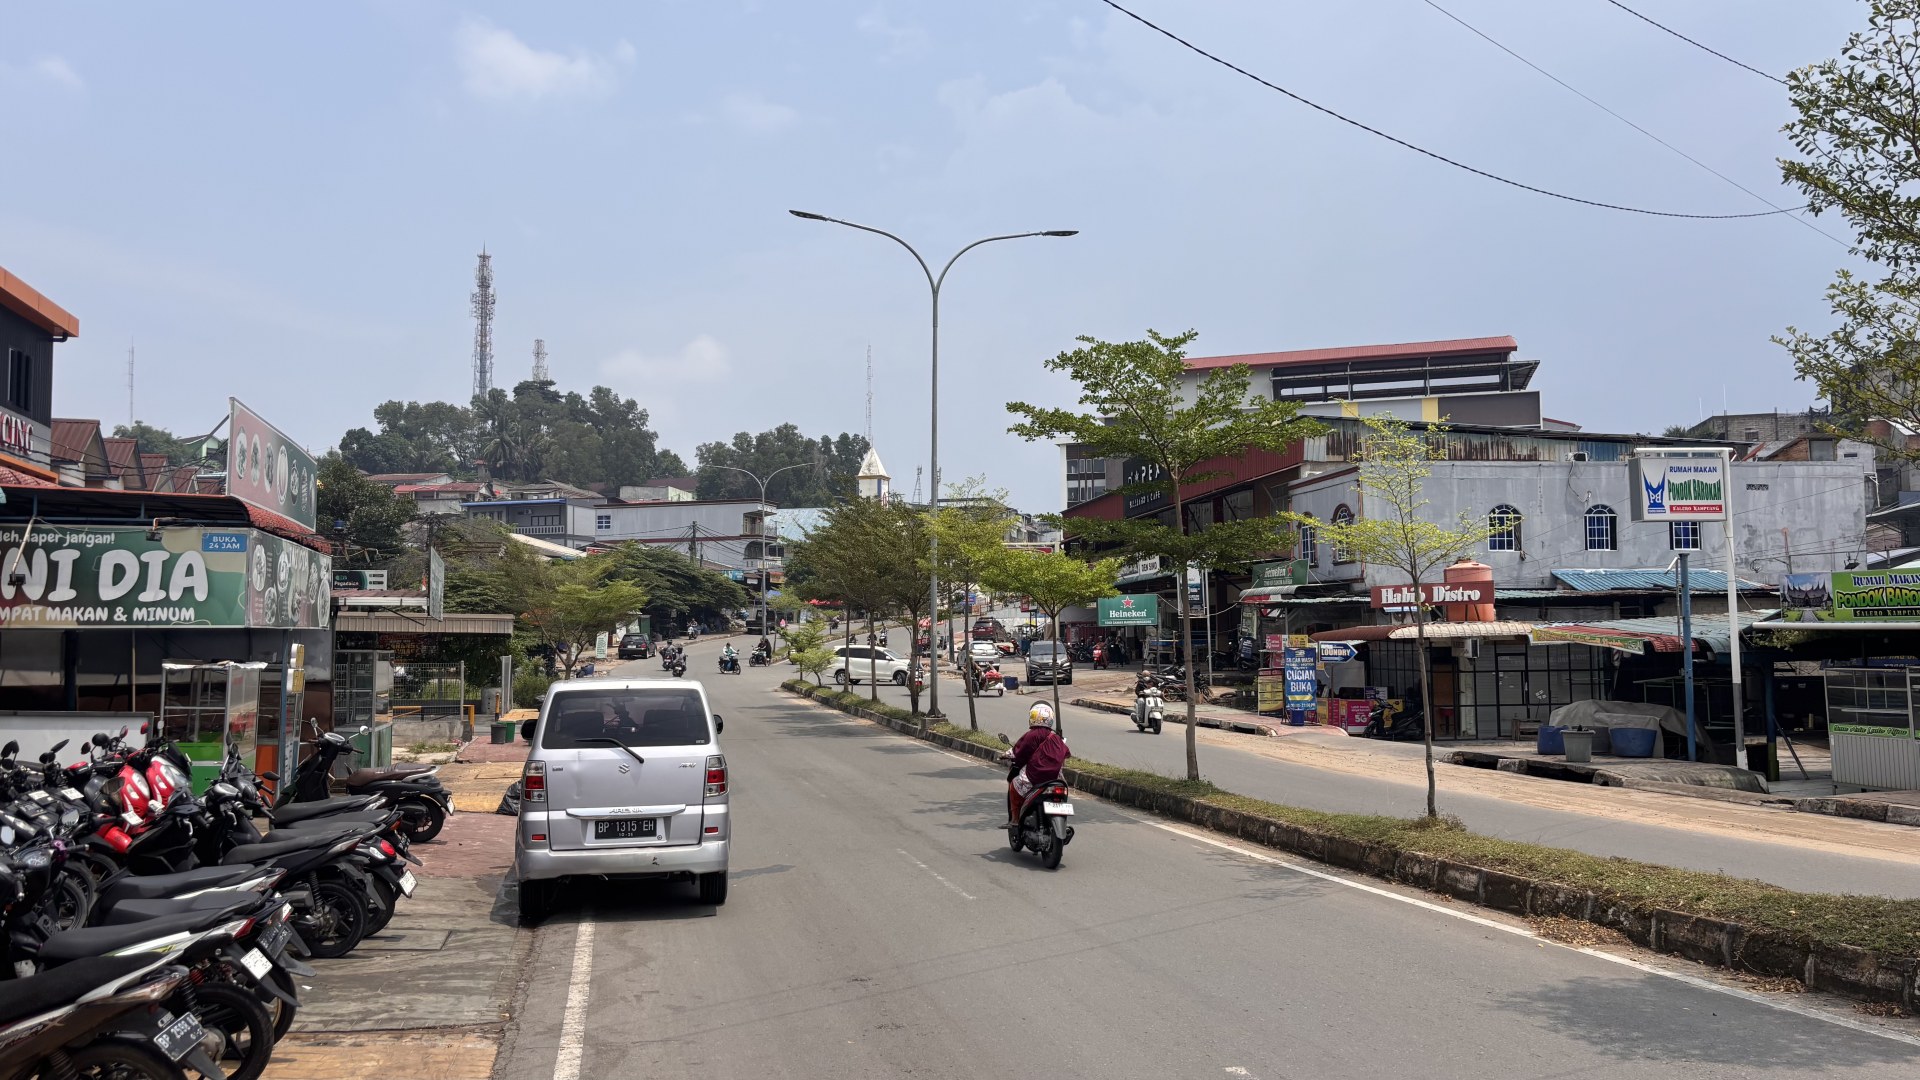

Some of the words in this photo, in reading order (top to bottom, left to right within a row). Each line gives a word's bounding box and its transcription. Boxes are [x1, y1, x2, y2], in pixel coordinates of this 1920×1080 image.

[1667, 478, 1693, 501] PONDOK
[1693, 478, 1722, 501] BAROKAH
[63, 531, 115, 548] jangan!
[98, 549, 209, 602] DIA
[1852, 575, 1885, 586] RUMAH
[1432, 585, 1480, 602] Distro
[1837, 587, 1885, 608] PONDOK
[1886, 587, 1920, 607] BARO
[46, 606, 108, 622] MAKAN
[114, 607, 127, 622] &
[133, 606, 195, 622] MINUM
[1109, 609, 1147, 618] Heineken
[1321, 648, 1351, 656] LOUNDRY
[1286, 669, 1316, 681] CUCIAN
[1290, 681, 1312, 692] BUKA
[1355, 714, 1367, 723] 5G
[598, 821, 609, 833] BP
[616, 820, 637, 832] 1315
[643, 820, 654, 831] EH
[157, 1034, 170, 1049] BP
